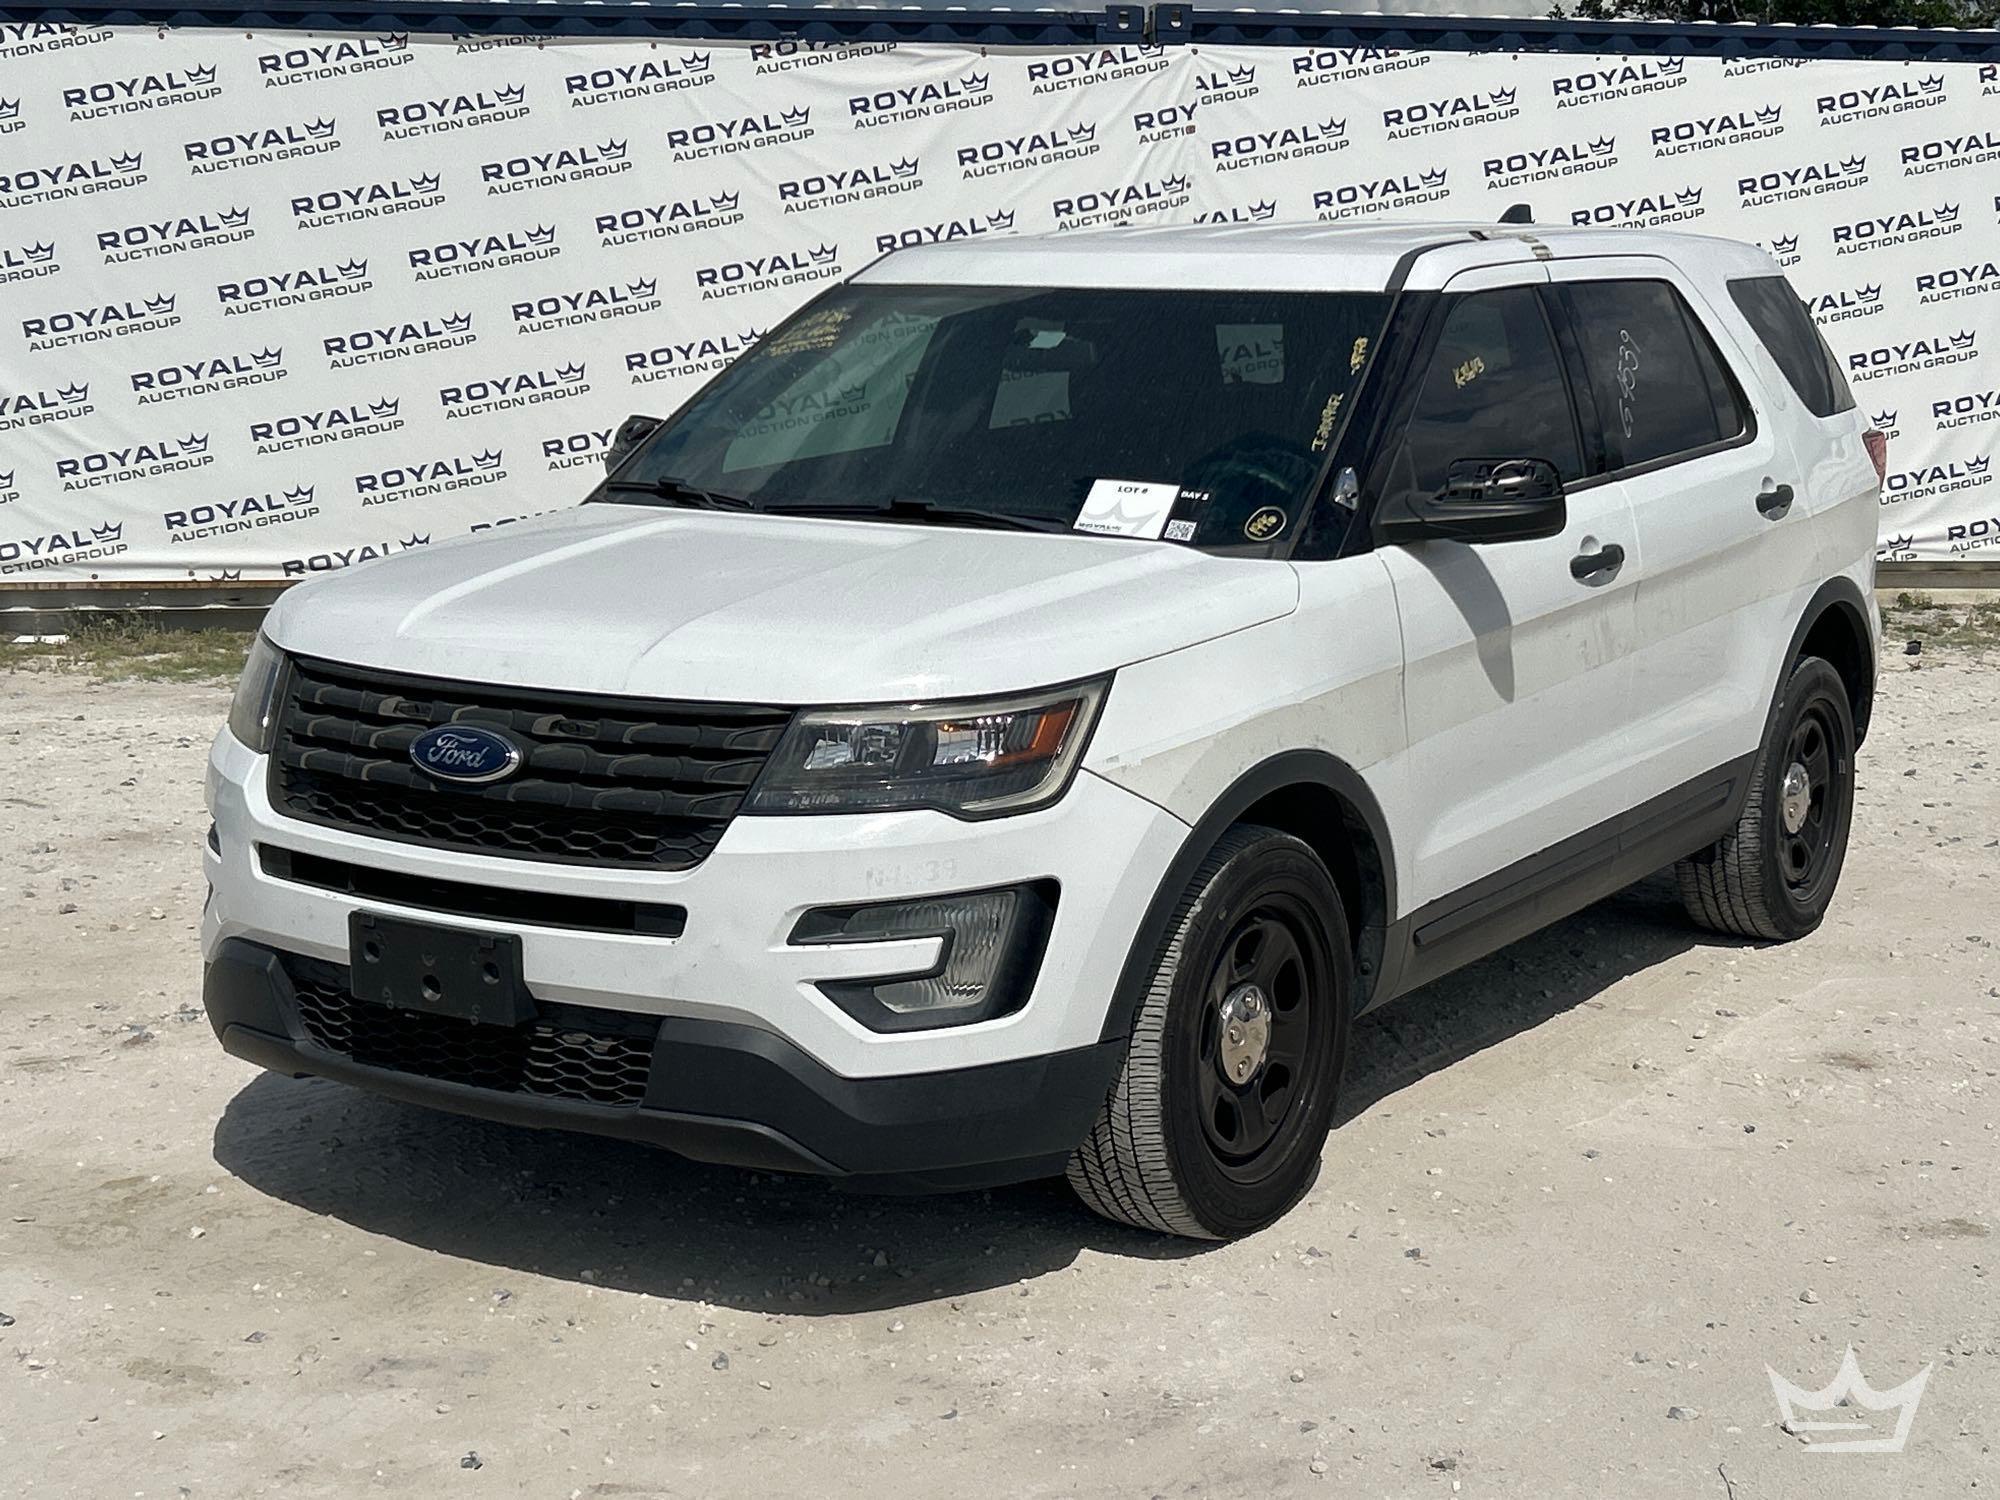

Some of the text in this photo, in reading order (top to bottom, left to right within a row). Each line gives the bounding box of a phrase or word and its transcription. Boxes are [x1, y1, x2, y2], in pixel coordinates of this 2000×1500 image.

[47, 30, 114, 51] GROUP
[258, 38, 380, 74] ROYAL
[455, 34, 537, 56] AUCTION
[755, 52, 833, 76] AUCTION
[836, 41, 898, 61] GROUP
[264, 52, 415, 89] AUCTION GROUP
[564, 59, 682, 95] ROYAL
[1026, 46, 1139, 82] ROYAL
[1031, 59, 1170, 96] AUCTION GROUP
[1296, 55, 1431, 89] AUCTION GROUP
[1552, 62, 1658, 97] ROYAL
[1723, 57, 1794, 78] AUCTION
[62, 72, 187, 108] ROYAL
[70, 86, 222, 123] AUCTION GROUP
[571, 73, 716, 108] AUCTION GROUP
[848, 80, 962, 116] ROYAL
[1200, 85, 1260, 106] GROUP
[1556, 76, 1688, 110] AUCTION GROUP
[1816, 81, 1919, 115] ROYAL
[376, 92, 497, 128] ROYAL
[383, 106, 531, 142] AUCTION GROUP
[854, 94, 994, 130] AUCTION GROUP
[1382, 94, 1490, 128] ROYAL
[1386, 108, 1520, 142] AUCTION GROUP
[1820, 94, 1947, 128] AUCTION GROUP
[183, 125, 307, 162] ROYAL
[666, 114, 782, 150] ROYAL
[672, 128, 815, 163] AUCTION GROUP
[1211, 125, 1320, 160] ROYAL
[1650, 112, 1756, 146] ROYAL
[1654, 125, 1785, 159] AUCTION GROUP
[190, 140, 342, 176] AUCTION GROUP
[480, 147, 599, 182] ROYAL
[956, 130, 1069, 167] ROYAL
[962, 144, 1100, 180] AUCTION GROUP
[1215, 138, 1350, 173] AUCTION GROUP
[1482, 143, 1589, 178] ROYAL
[1900, 132, 2000, 165] ROYAL
[1903, 155, 1973, 178] AUCTION
[81, 174, 148, 195] GROUP
[487, 161, 633, 196] AUCTION GROUP
[778, 165, 892, 201] ROYAL
[1487, 156, 1619, 191] AUCTION GROUP
[1737, 162, 1841, 196] ROYAL
[290, 180, 412, 217] ROYAL
[784, 178, 924, 215] AUCTION GROUP
[1052, 181, 1162, 219] ROYAL
[1312, 175, 1420, 210] ROYAL
[1318, 188, 1450, 222] AUCTION GROUP
[1741, 175, 1869, 209] AUCTION GROUP
[297, 195, 446, 231] AUCTION GROUP
[594, 199, 712, 235] ROYAL
[1058, 195, 1190, 232] AUCTION GROUP
[1570, 194, 1676, 227] ROYAL
[1648, 207, 1706, 227] GROUP
[1832, 210, 1934, 244] ROYAL
[96, 215, 220, 252] ROYAL
[104, 229, 256, 266] AUCTION GROUP
[601, 212, 745, 248] AUCTION GROUP
[875, 217, 988, 253] ROYAL
[1836, 223, 1963, 256] AUCTION GROUP
[408, 232, 527, 268] ROYAL
[414, 246, 561, 282] AUCTION GROUP
[216, 267, 339, 303] ROYAL
[695, 252, 810, 288] ROYAL
[702, 265, 842, 301] AUCTION GROUP
[1915, 262, 2000, 293] ROYA
[224, 280, 374, 317] AUCTION GROUP
[511, 286, 629, 322] ROYAL
[1919, 282, 1989, 305] AUCTION
[21, 302, 146, 339] ROYAL
[518, 299, 662, 336] AUCTION GROUP
[1830, 303, 1885, 323] GROUP
[29, 316, 182, 353] AUCTION GROUP
[322, 320, 444, 356] ROYAL
[330, 334, 477, 370] AUCTION GROUP
[624, 336, 740, 372] ROYAL
[1848, 337, 1950, 372] ROYAL
[1852, 350, 1979, 384] AUCTION GROUP
[130, 355, 254, 392] ROYAL
[137, 368, 288, 406] AUCTION GROUP
[439, 370, 558, 406] ROYAL
[631, 361, 709, 385] AUCTION
[28, 404, 95, 426] GROUP
[446, 384, 591, 420] AUCTION GROUP
[813, 402, 872, 424] GROUP
[249, 405, 371, 442] ROYAL
[256, 419, 405, 456] AUCTION GROUP
[55, 442, 180, 479] ROYAL
[541, 428, 613, 458] ROY
[63, 455, 215, 492] AUCTION GROUP
[354, 458, 474, 494] ROYAL
[548, 451, 610, 472] AUCTIO
[1886, 462, 1966, 491] OYAL
[361, 470, 508, 508] AUCTION GROUP
[1117, 485, 1140, 495] LOT
[1879, 474, 1993, 506] UCTION GROUP
[163, 493, 286, 531] ROYAL
[170, 506, 320, 544] AUCTION GROUP
[0, 530, 93, 562] OYAL
[62, 543, 128, 564] GROUP
[426, 732, 490, 769] Ford
